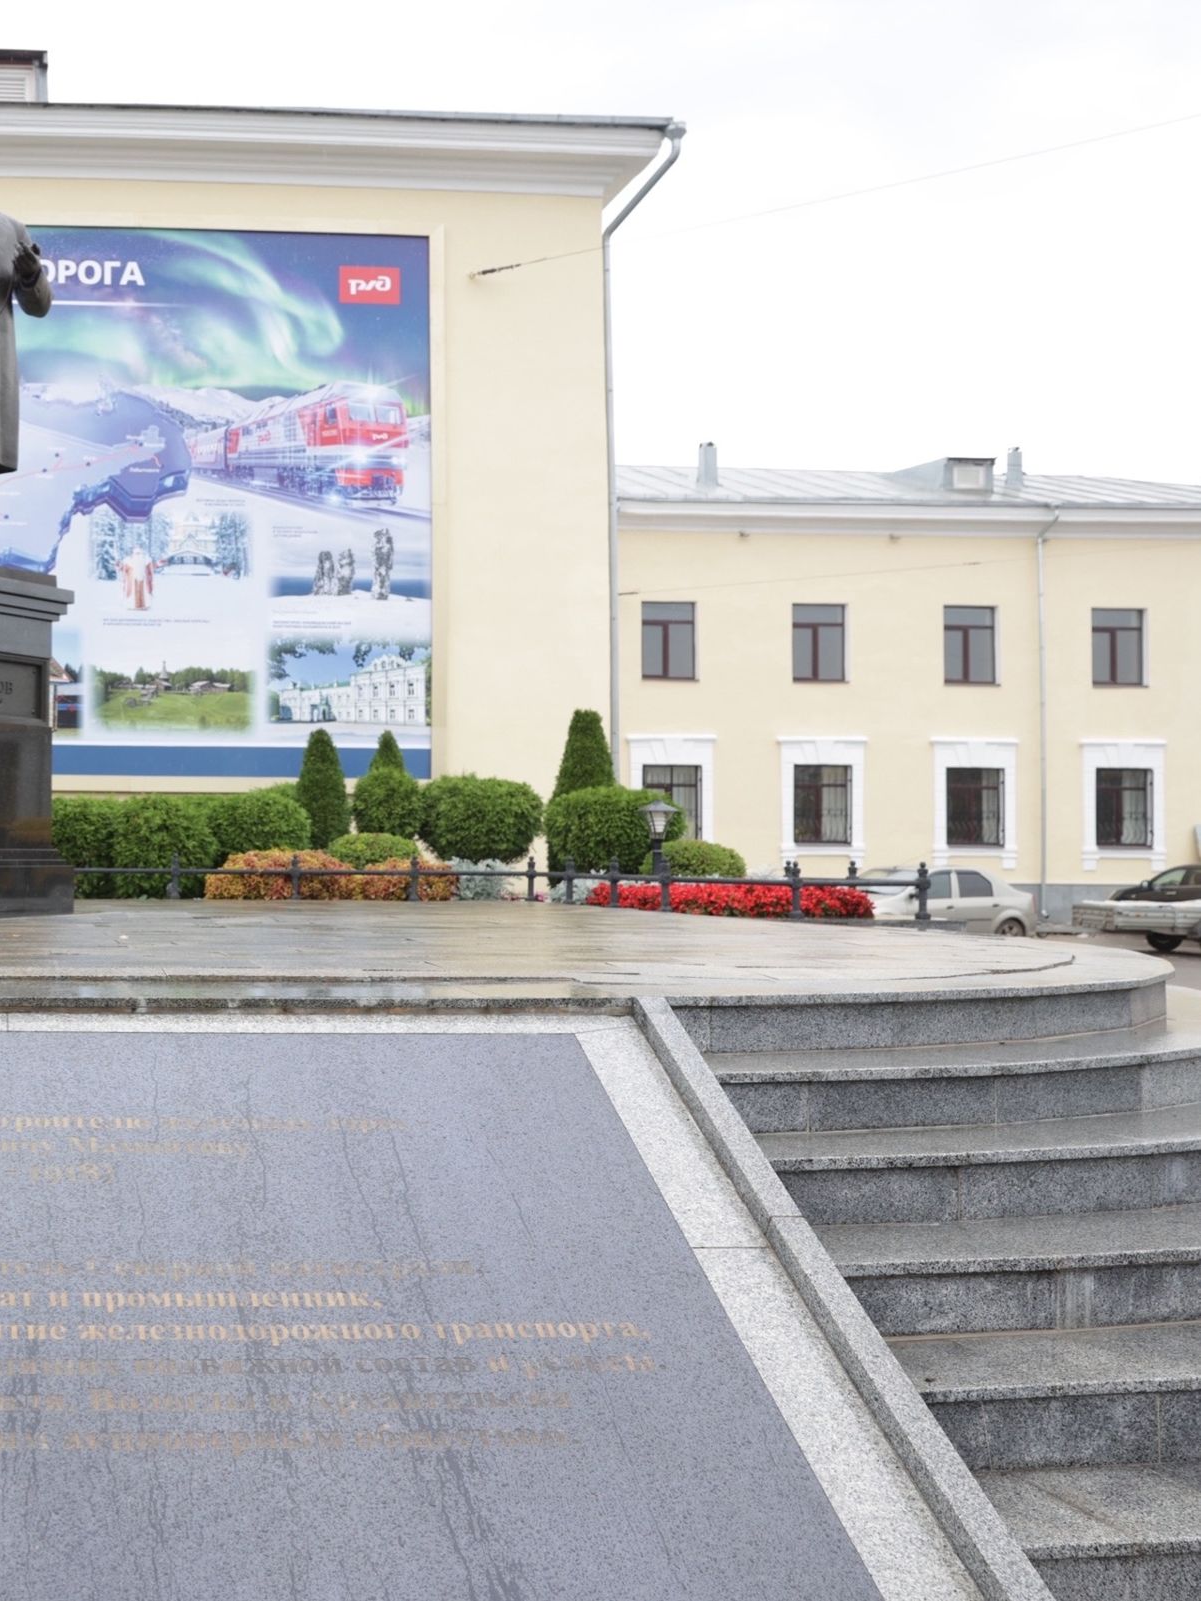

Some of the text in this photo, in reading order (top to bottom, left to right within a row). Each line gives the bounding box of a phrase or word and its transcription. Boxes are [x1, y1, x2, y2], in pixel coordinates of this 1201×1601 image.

[36, 259, 146, 287] ОРОГА
[49, 1291, 68, 1307] и
[82, 1290, 384, 1313] промышленник,
[79, 1322, 421, 1346] железнодорожного
[434, 1320, 653, 1346] транспорта,
